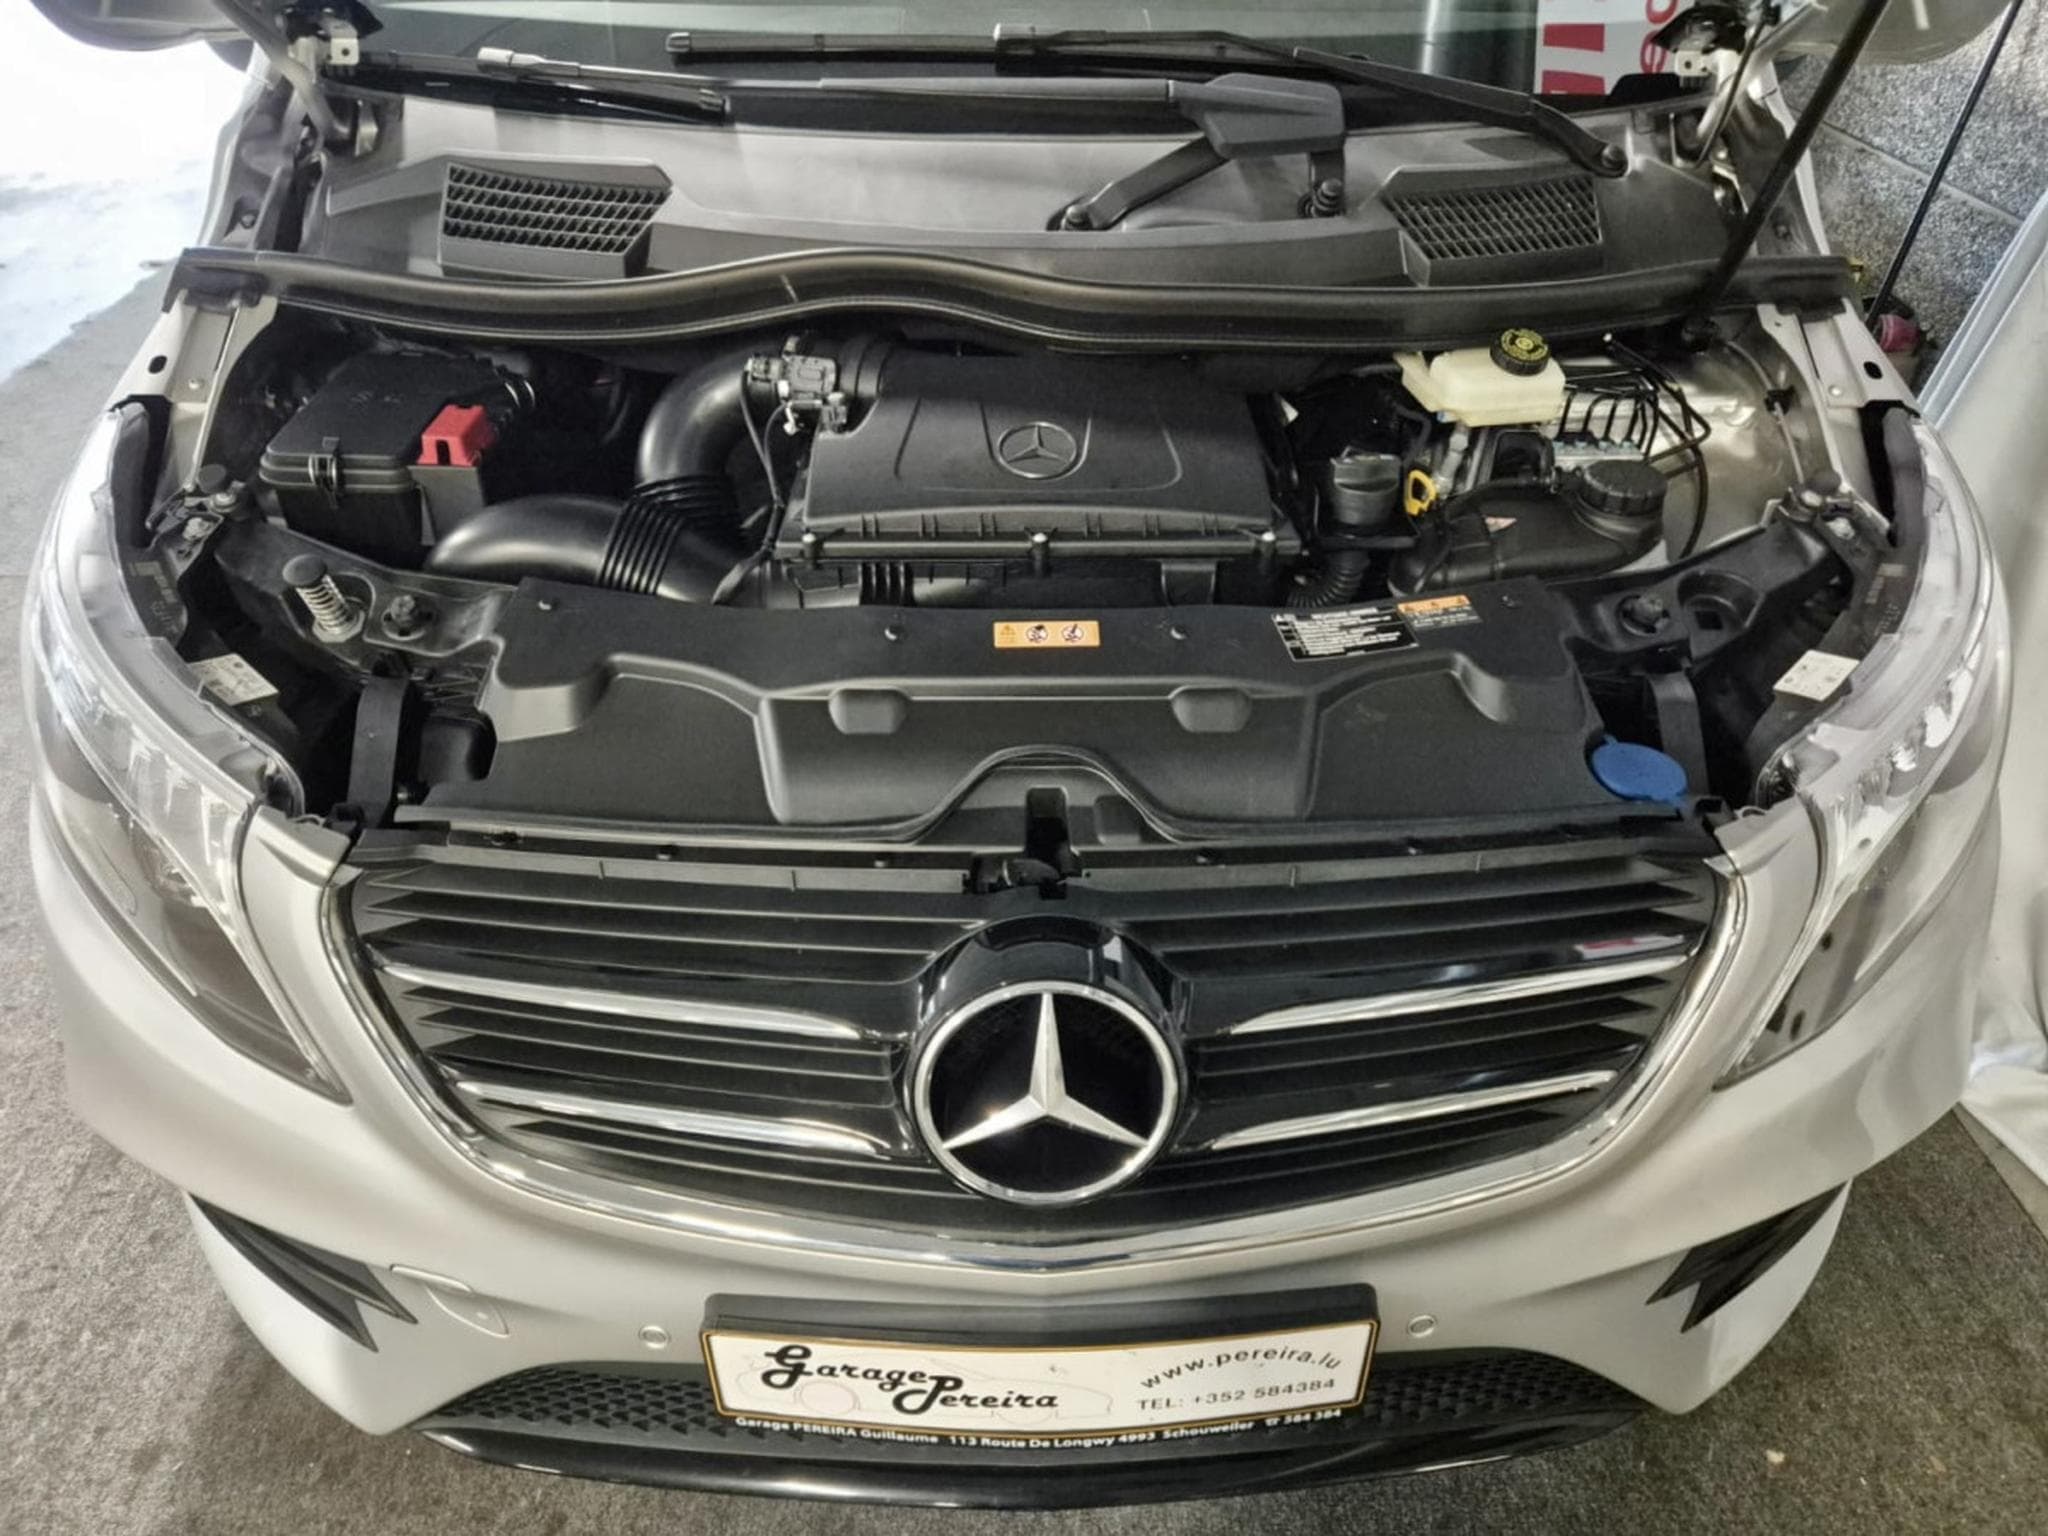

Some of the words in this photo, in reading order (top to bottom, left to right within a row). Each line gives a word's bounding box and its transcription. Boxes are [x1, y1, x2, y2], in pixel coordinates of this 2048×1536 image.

[761, 1344, 928, 1392] Garage
[892, 1374, 1059, 1416] Pereira
[1140, 1346, 1341, 1389] www.pereira.lu
[1137, 1397, 1184, 1411] TEL:
[1194, 1390, 1246, 1405] +352
[1253, 1377, 1337, 1400] 584384
[735, 1416, 790, 1431] Garage
[793, 1422, 857, 1437] PEREIRA
[860, 1429, 939, 1444] Guillaume
[980, 1437, 1026, 1448] Route
[1053, 1435, 1114, 1448] Longwy
